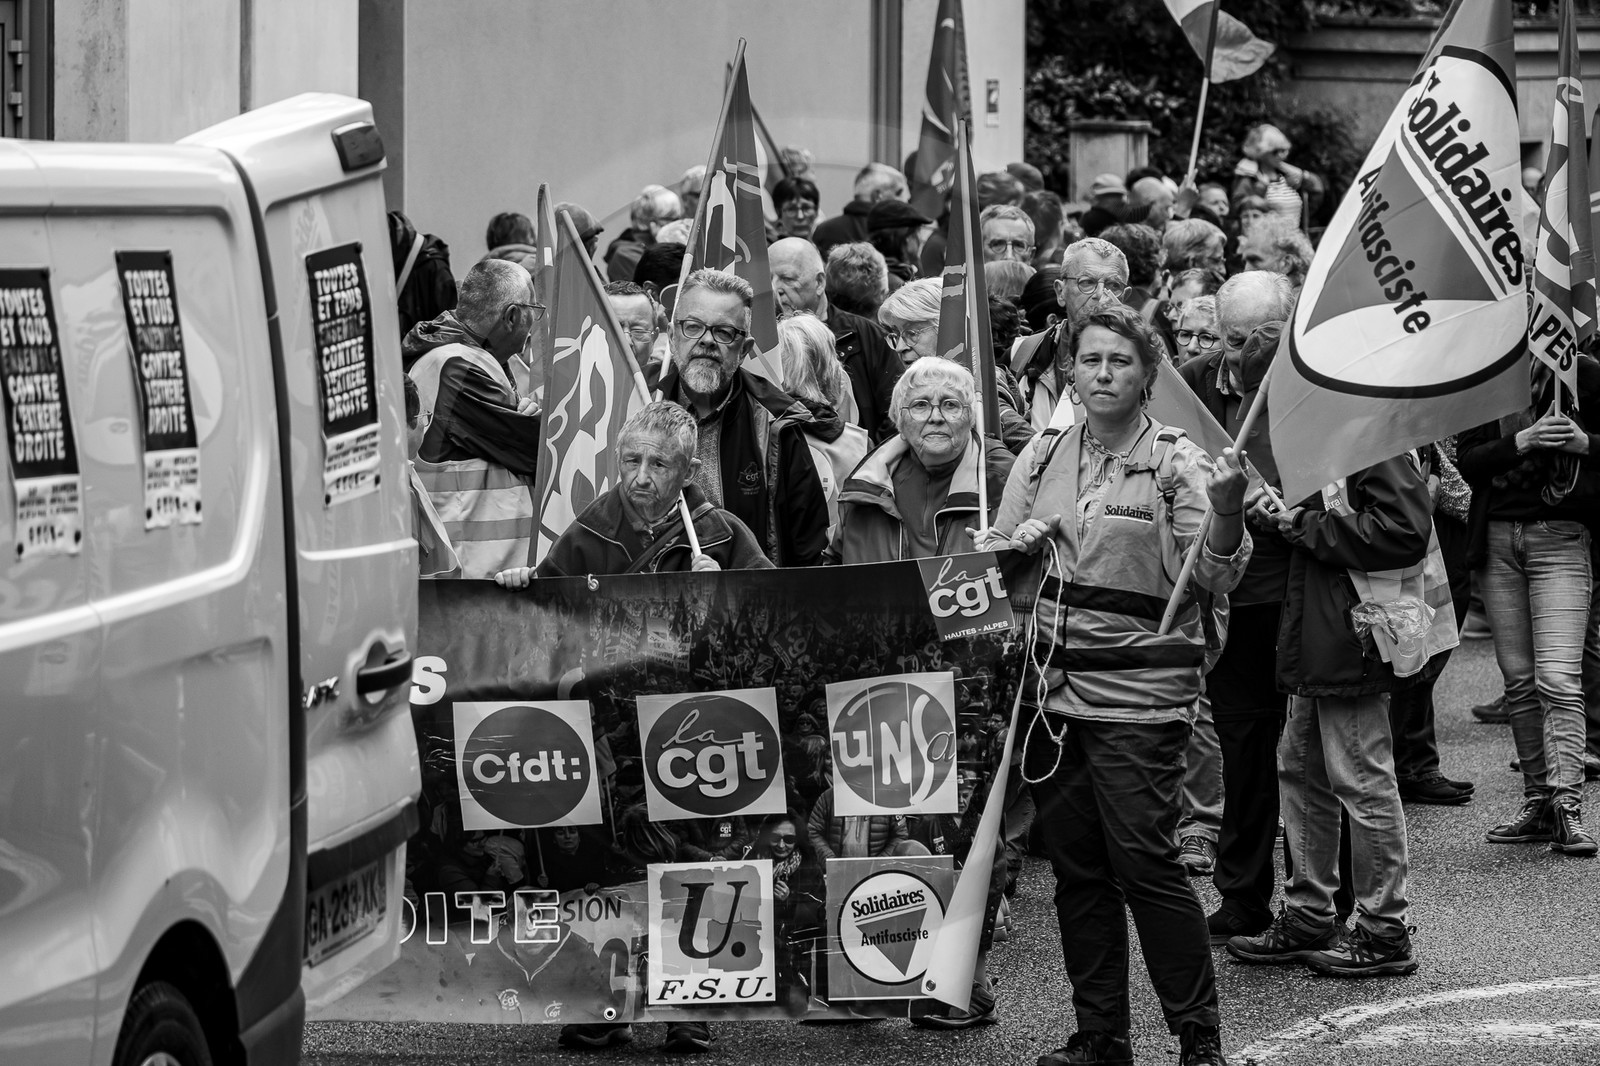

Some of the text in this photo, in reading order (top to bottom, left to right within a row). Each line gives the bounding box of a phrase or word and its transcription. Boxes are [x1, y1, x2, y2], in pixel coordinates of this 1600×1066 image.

[1358, 164, 1431, 334] Aifasciste
[124, 270, 170, 297] TOUTES
[314, 262, 359, 296] TOUTES
[129, 297, 175, 325] ET TOUS
[317, 286, 363, 320] ET TOUS
[0, 316, 52, 345] ET TOUS
[141, 350, 183, 378] CONTRE
[322, 336, 365, 372] CONTRE
[8, 373, 59, 404] CONTRE
[148, 404, 188, 434] DROITE
[327, 386, 369, 422] DROITE
[15, 430, 66, 463] DROITE
[1104, 504, 1154, 521] Solidaires
[928, 566, 1008, 618] cgt
[944, 627, 977, 640] HAUTES
[983, 620, 1009, 632] ALPES
[657, 731, 767, 798] cgt
[851, 889, 925, 918] Solidaires
[861, 927, 929, 947] Antifasciste
[656, 976, 773, 1000] F.S.U.
